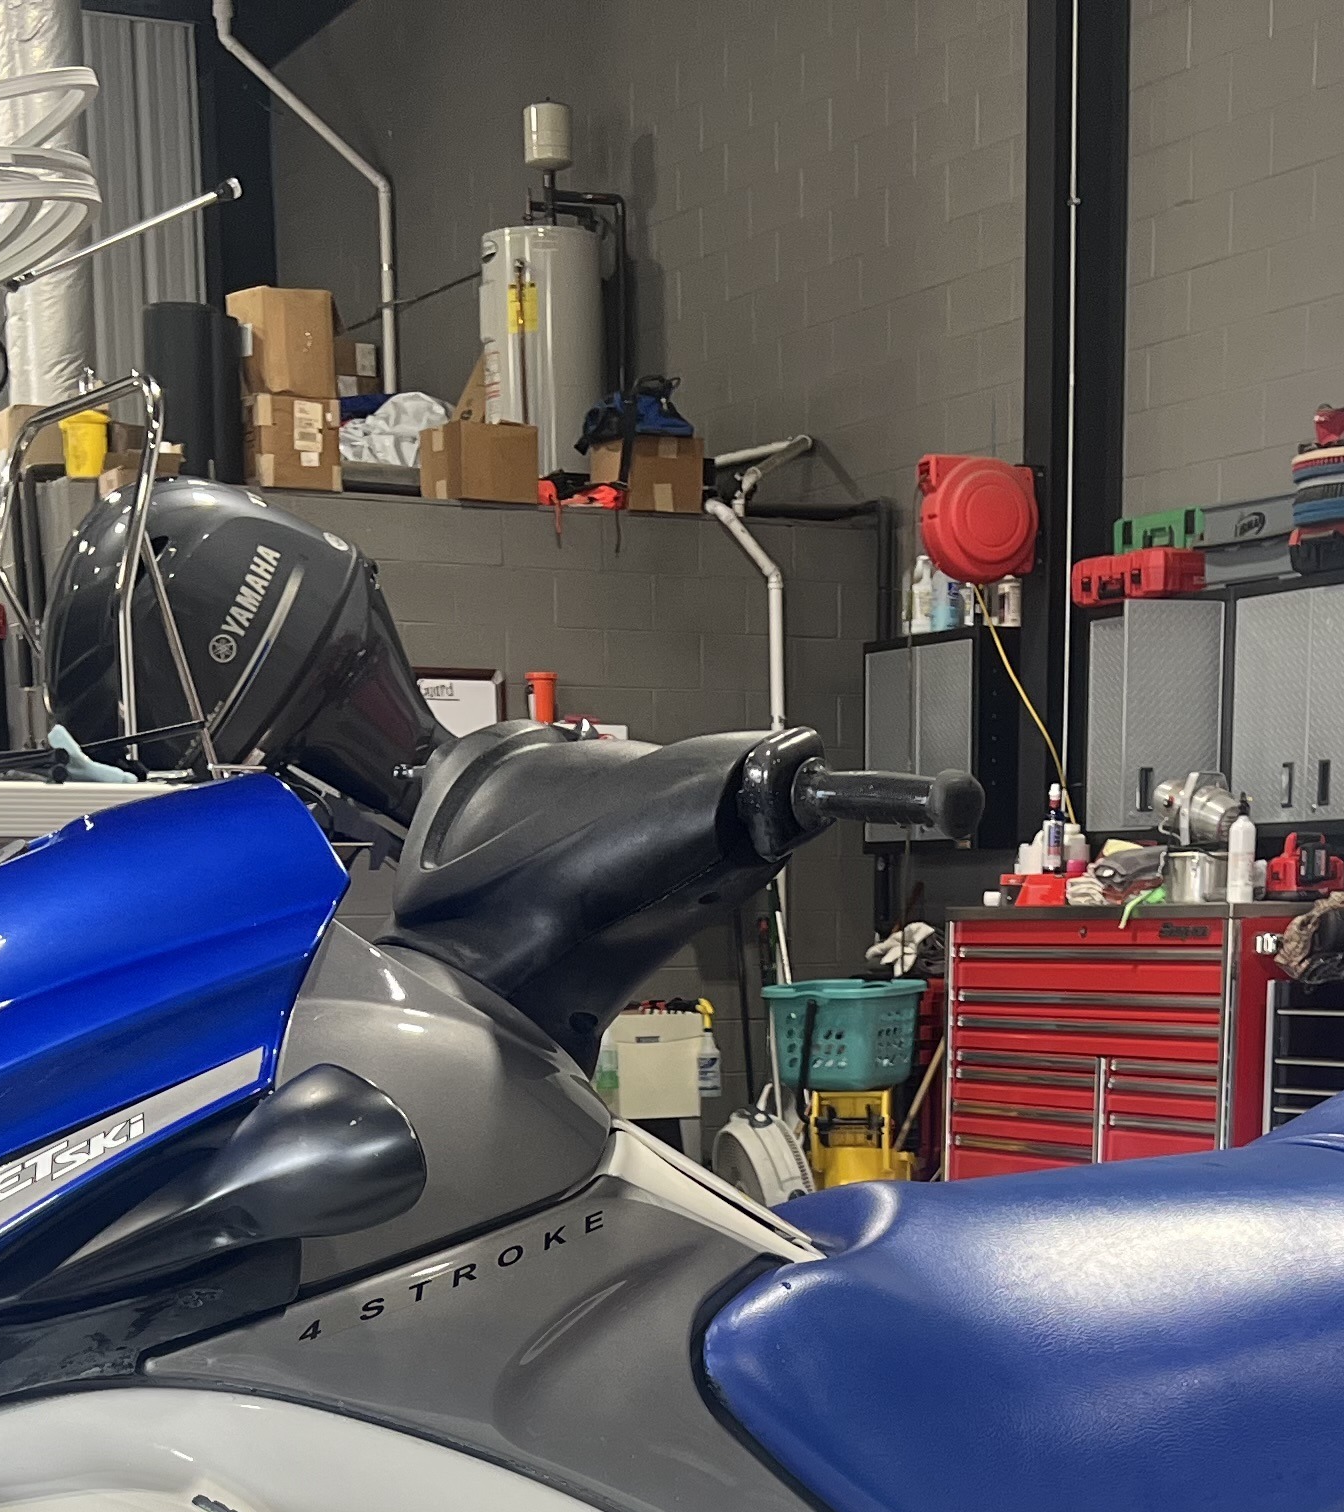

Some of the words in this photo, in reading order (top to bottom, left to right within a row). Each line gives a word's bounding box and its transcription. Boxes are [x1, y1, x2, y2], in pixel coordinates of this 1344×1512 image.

[221, 545, 282, 637] YAMAHA
[298, 1319, 322, 1343] 4
[360, 1210, 605, 1322] STROKE
